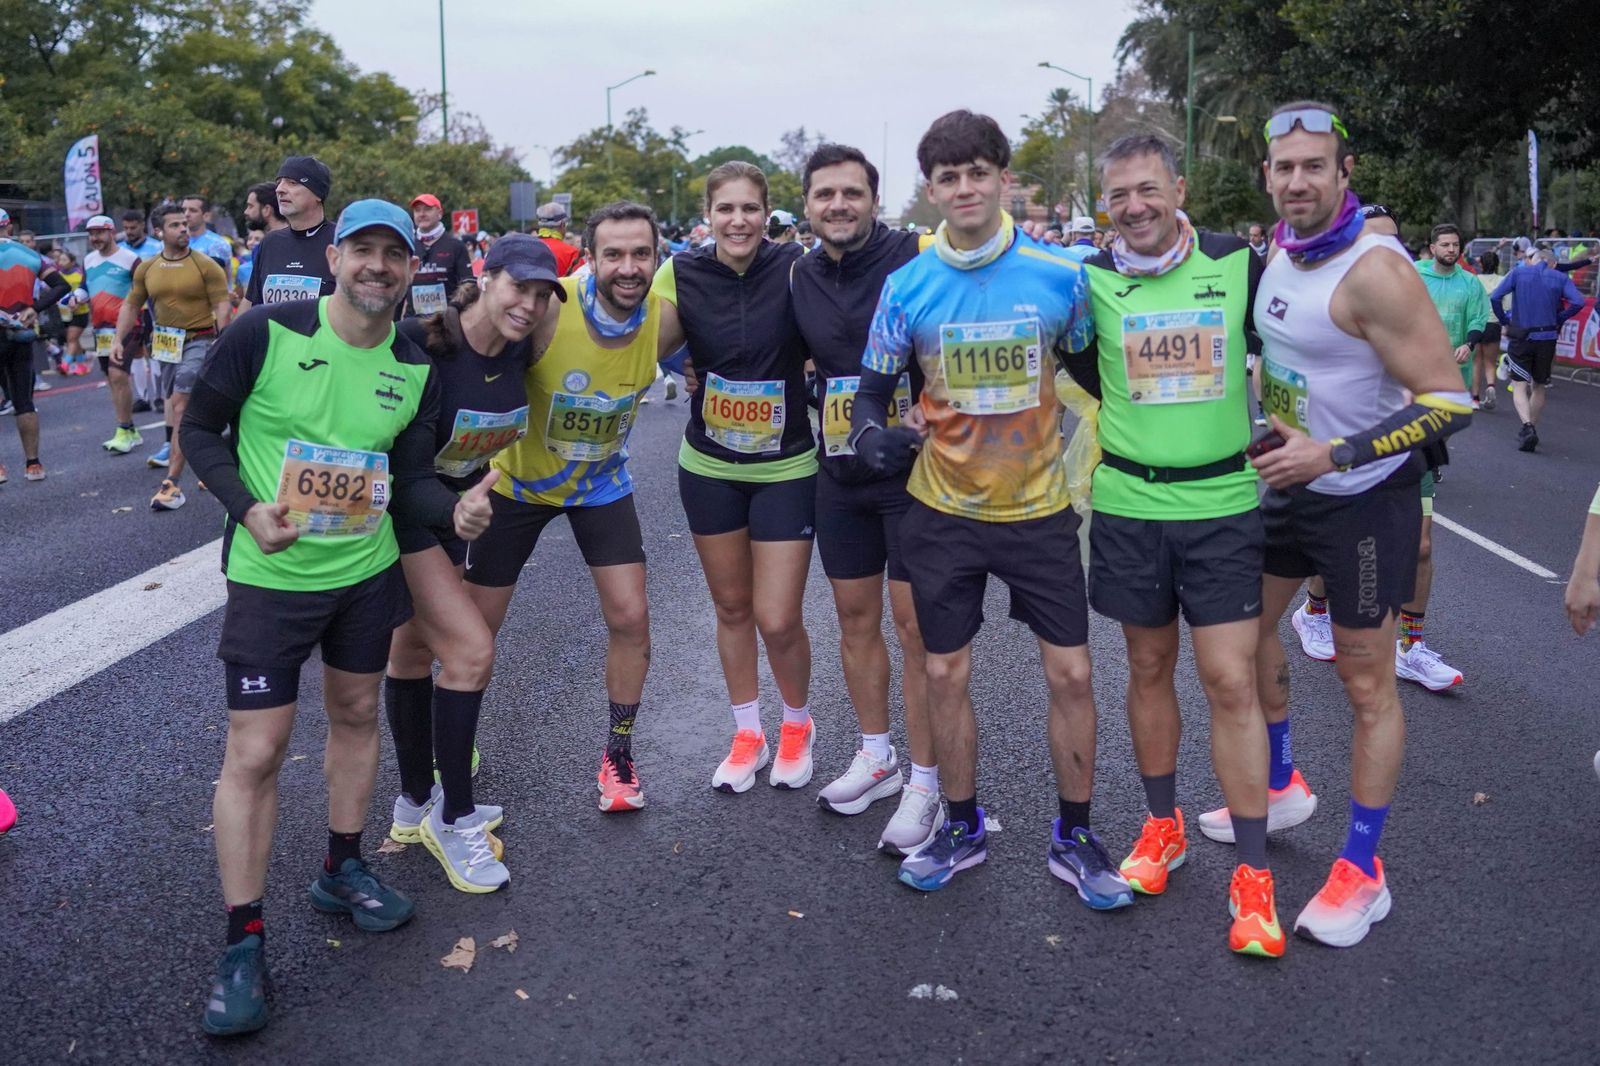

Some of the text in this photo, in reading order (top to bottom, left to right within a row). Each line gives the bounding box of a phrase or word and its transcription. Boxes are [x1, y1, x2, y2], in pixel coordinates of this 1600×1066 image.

[78, 146, 95, 158] 5
[952, 345, 1024, 374] 11166
[1138, 333, 1202, 362] 4491
[710, 394, 772, 422] 16089
[563, 411, 617, 434] 8517
[297, 468, 366, 502] 6382
